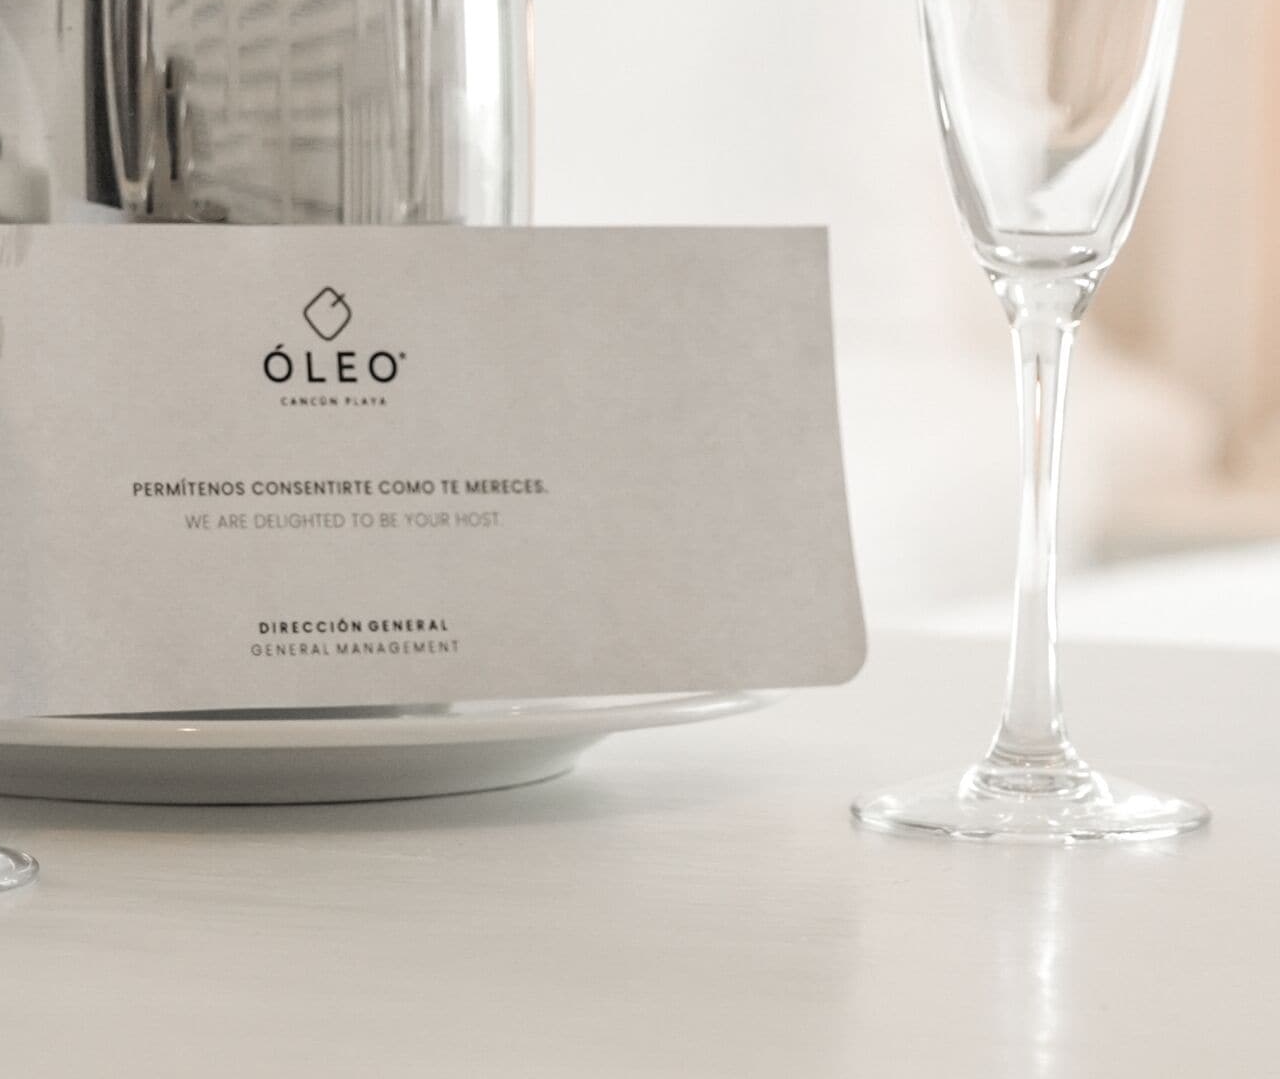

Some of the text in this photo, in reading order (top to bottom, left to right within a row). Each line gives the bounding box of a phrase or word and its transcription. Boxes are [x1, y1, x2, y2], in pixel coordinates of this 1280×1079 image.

[279, 395, 387, 407] CANCÚN PLAYA
[132, 477, 549, 497] PERMÍTENOS CONSENTIRTE COMO TE MERECES.
[185, 513, 210, 530] WE
[217, 513, 248, 529] ARE
[253, 512, 346, 529] DELIGHTED
[351, 512, 375, 529] TO
[379, 512, 398, 528] BE
[404, 511, 451, 528] YOUR
[258, 618, 449, 634] DIRECCIÓN GENERAL
[250, 640, 459, 657] GENERAL MANAGEMENT
